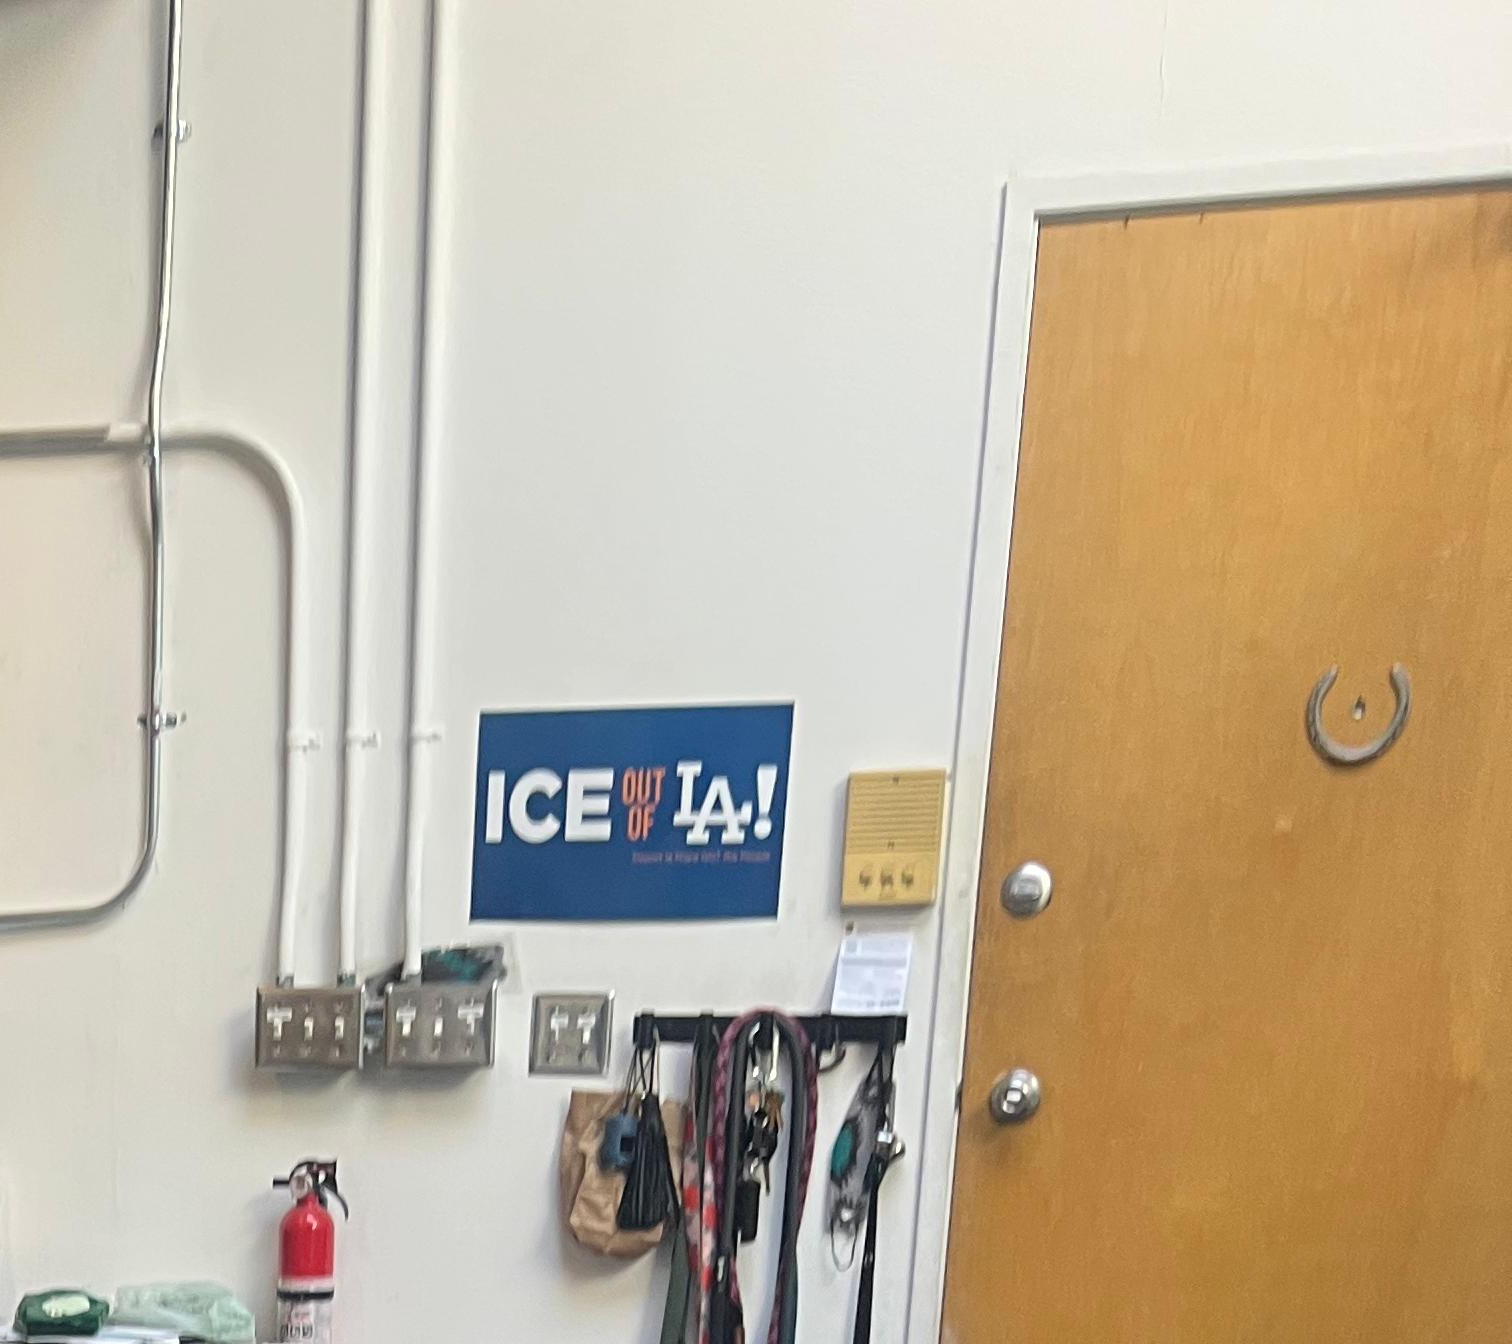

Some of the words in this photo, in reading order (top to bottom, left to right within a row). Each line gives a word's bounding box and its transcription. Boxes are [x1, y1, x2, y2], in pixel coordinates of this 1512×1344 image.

[485, 767, 615, 844] ICE
[621, 766, 666, 805] OUT
[673, 759, 778, 846] LA!
[626, 804, 657, 842] OF
